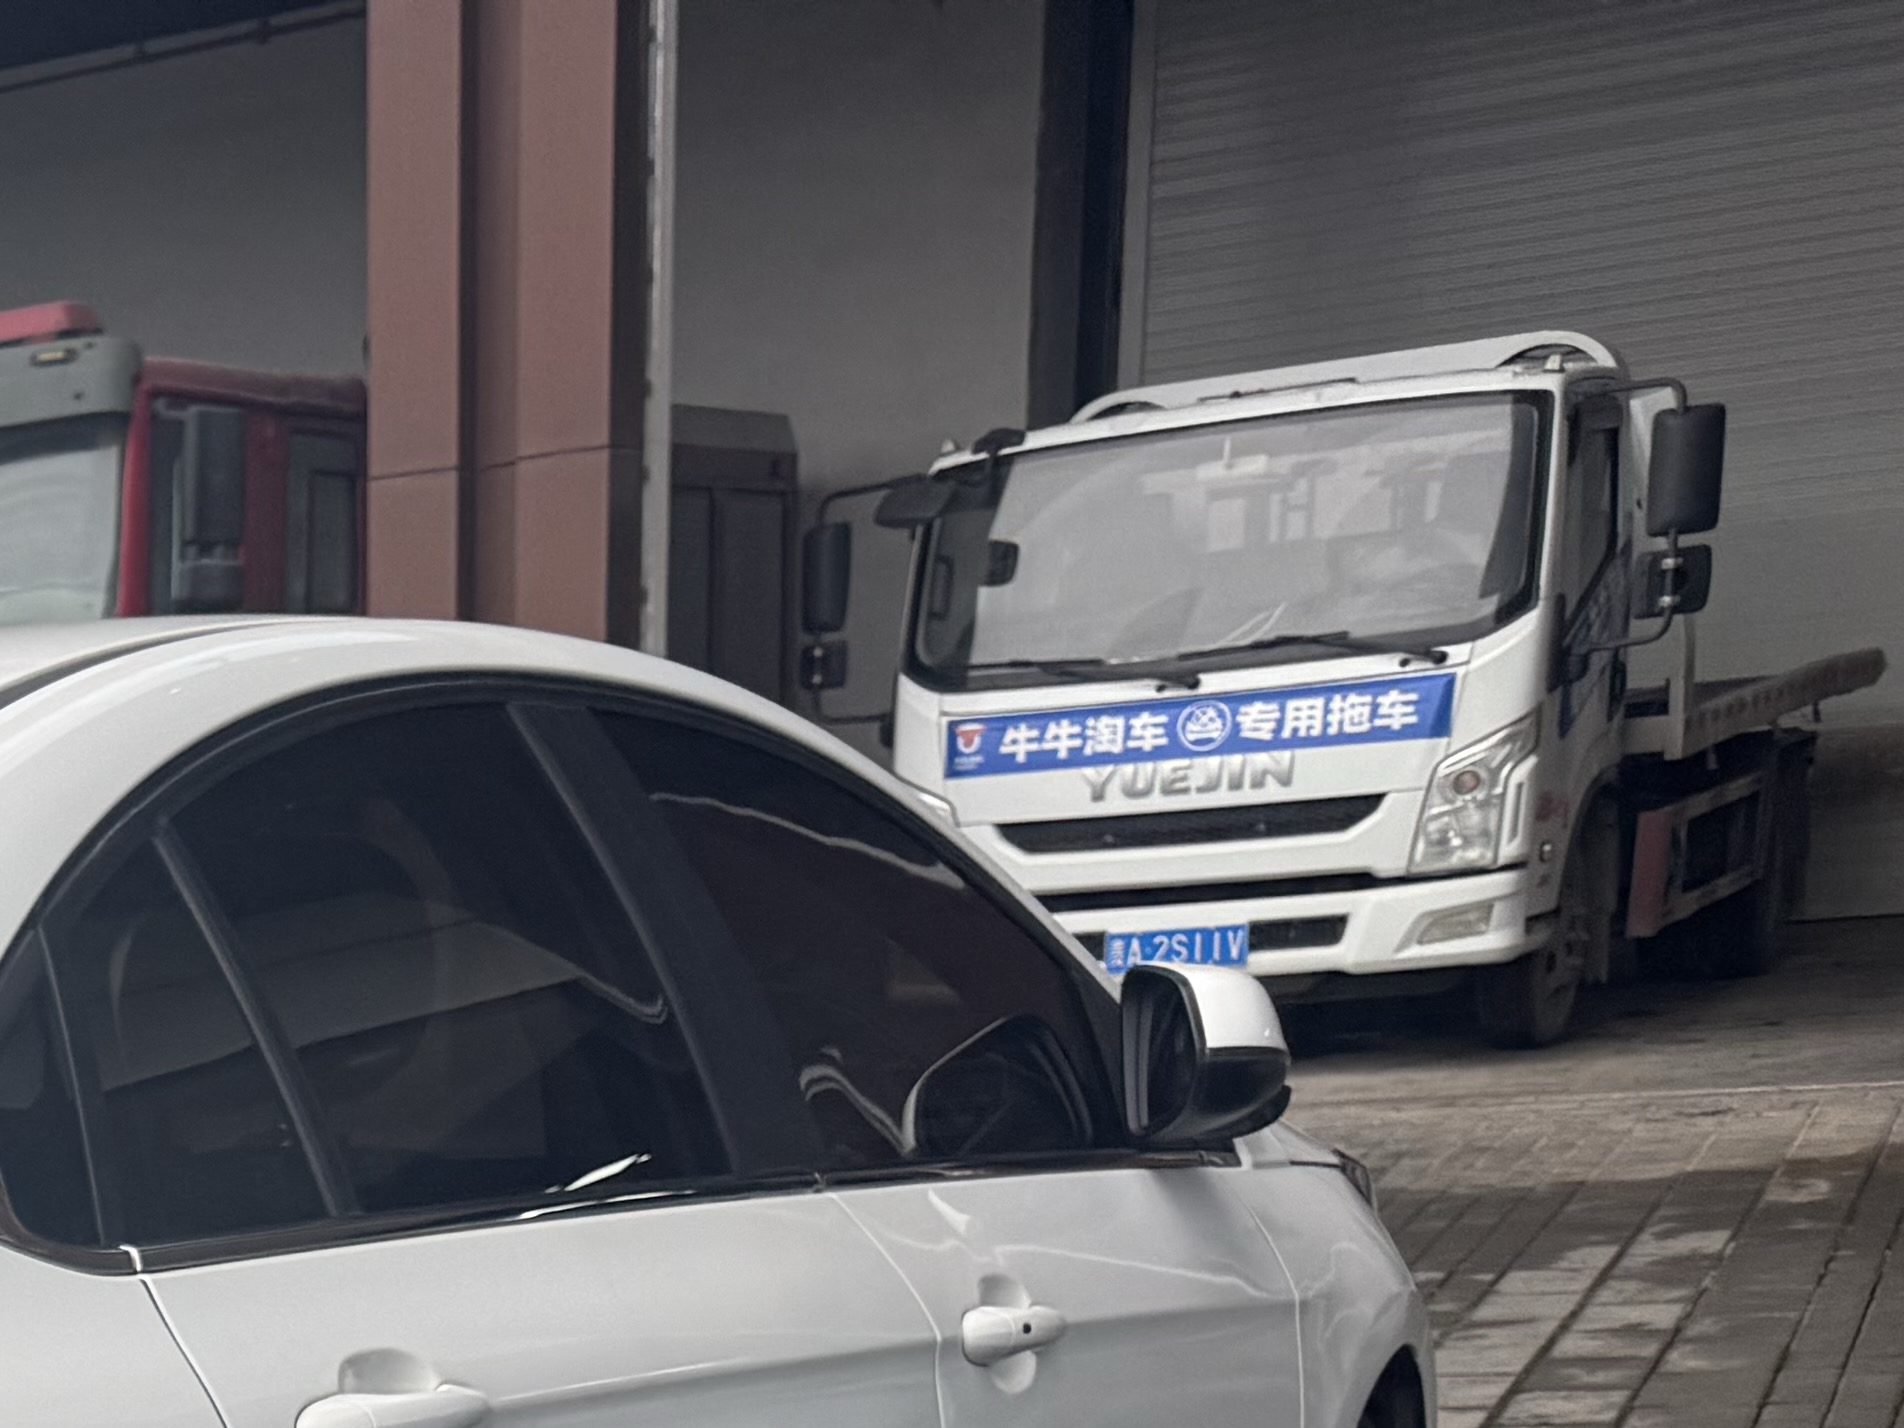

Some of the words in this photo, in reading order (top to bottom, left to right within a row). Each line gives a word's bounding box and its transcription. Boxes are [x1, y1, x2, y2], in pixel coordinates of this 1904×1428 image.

[997, 711, 1170, 764] 牛牛淘车
[1235, 689, 1420, 741] 专用拖车
[1082, 750, 1296, 803] YUEJIN
